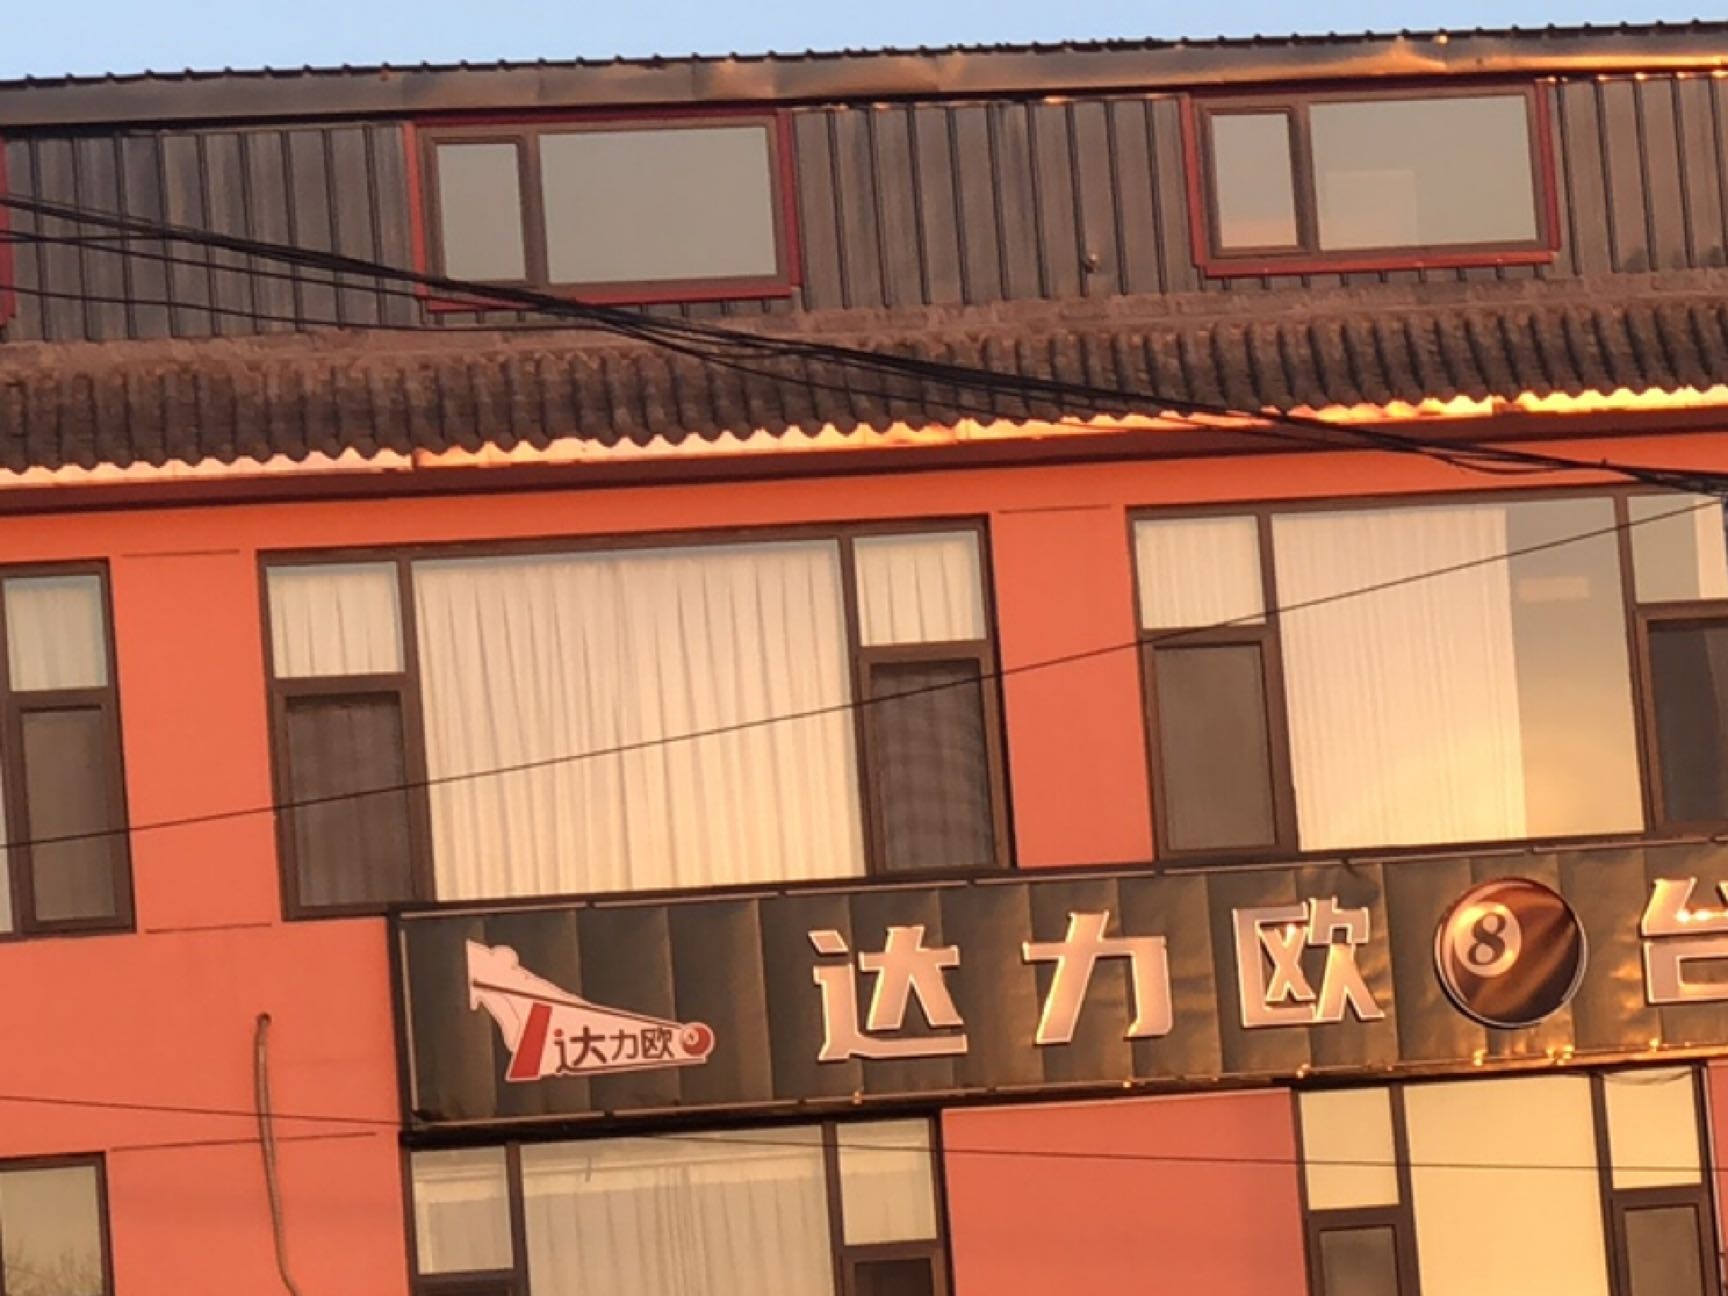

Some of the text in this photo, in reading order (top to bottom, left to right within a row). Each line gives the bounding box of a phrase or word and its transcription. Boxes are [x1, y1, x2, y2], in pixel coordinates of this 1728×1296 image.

[807, 896, 1385, 1062] 达力欧
[1467, 914, 1507, 966] 8
[554, 1024, 674, 1072] 达力欧
